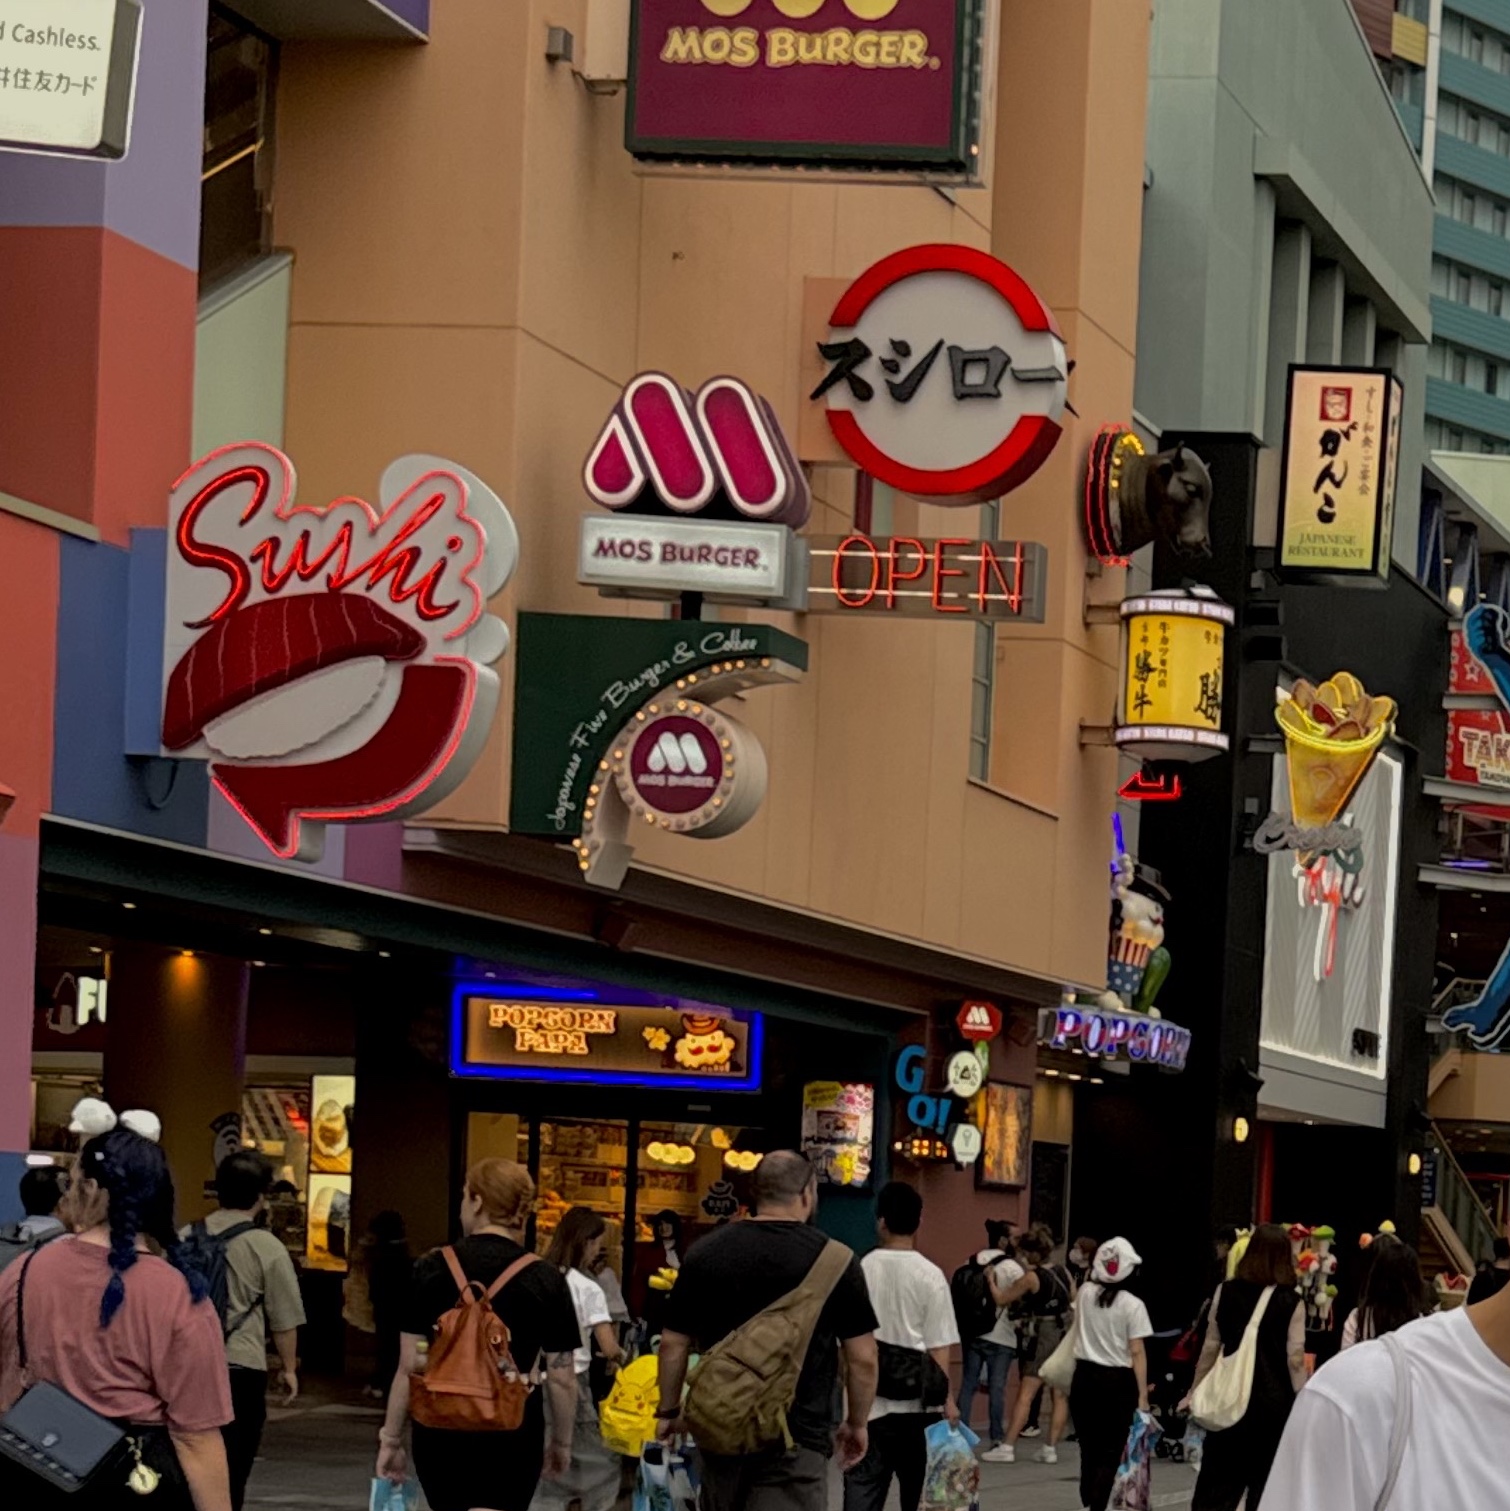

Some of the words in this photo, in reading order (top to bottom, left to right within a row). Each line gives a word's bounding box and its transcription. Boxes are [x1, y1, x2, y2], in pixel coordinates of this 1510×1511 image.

[11, 23, 101, 51] Cashless.
[660, 27, 759, 66] MOS
[809, 337, 1065, 403] スシロー
[1313, 421, 1358, 524] がんこ
[176, 465, 460, 630] Sushi
[593, 538, 652, 562] MOS
[1287, 544, 1365, 560] RESTAURANT
[1299, 533, 1357, 546] JAPANESE
[832, 536, 1023, 614] OPEN
[601, 660, 671, 709] Burger
[672, 641, 696, 665] &
[700, 628, 758, 655] Coffee
[489, 1004, 616, 1034] POPCORN
[515, 1028, 589, 1055] PAPA
